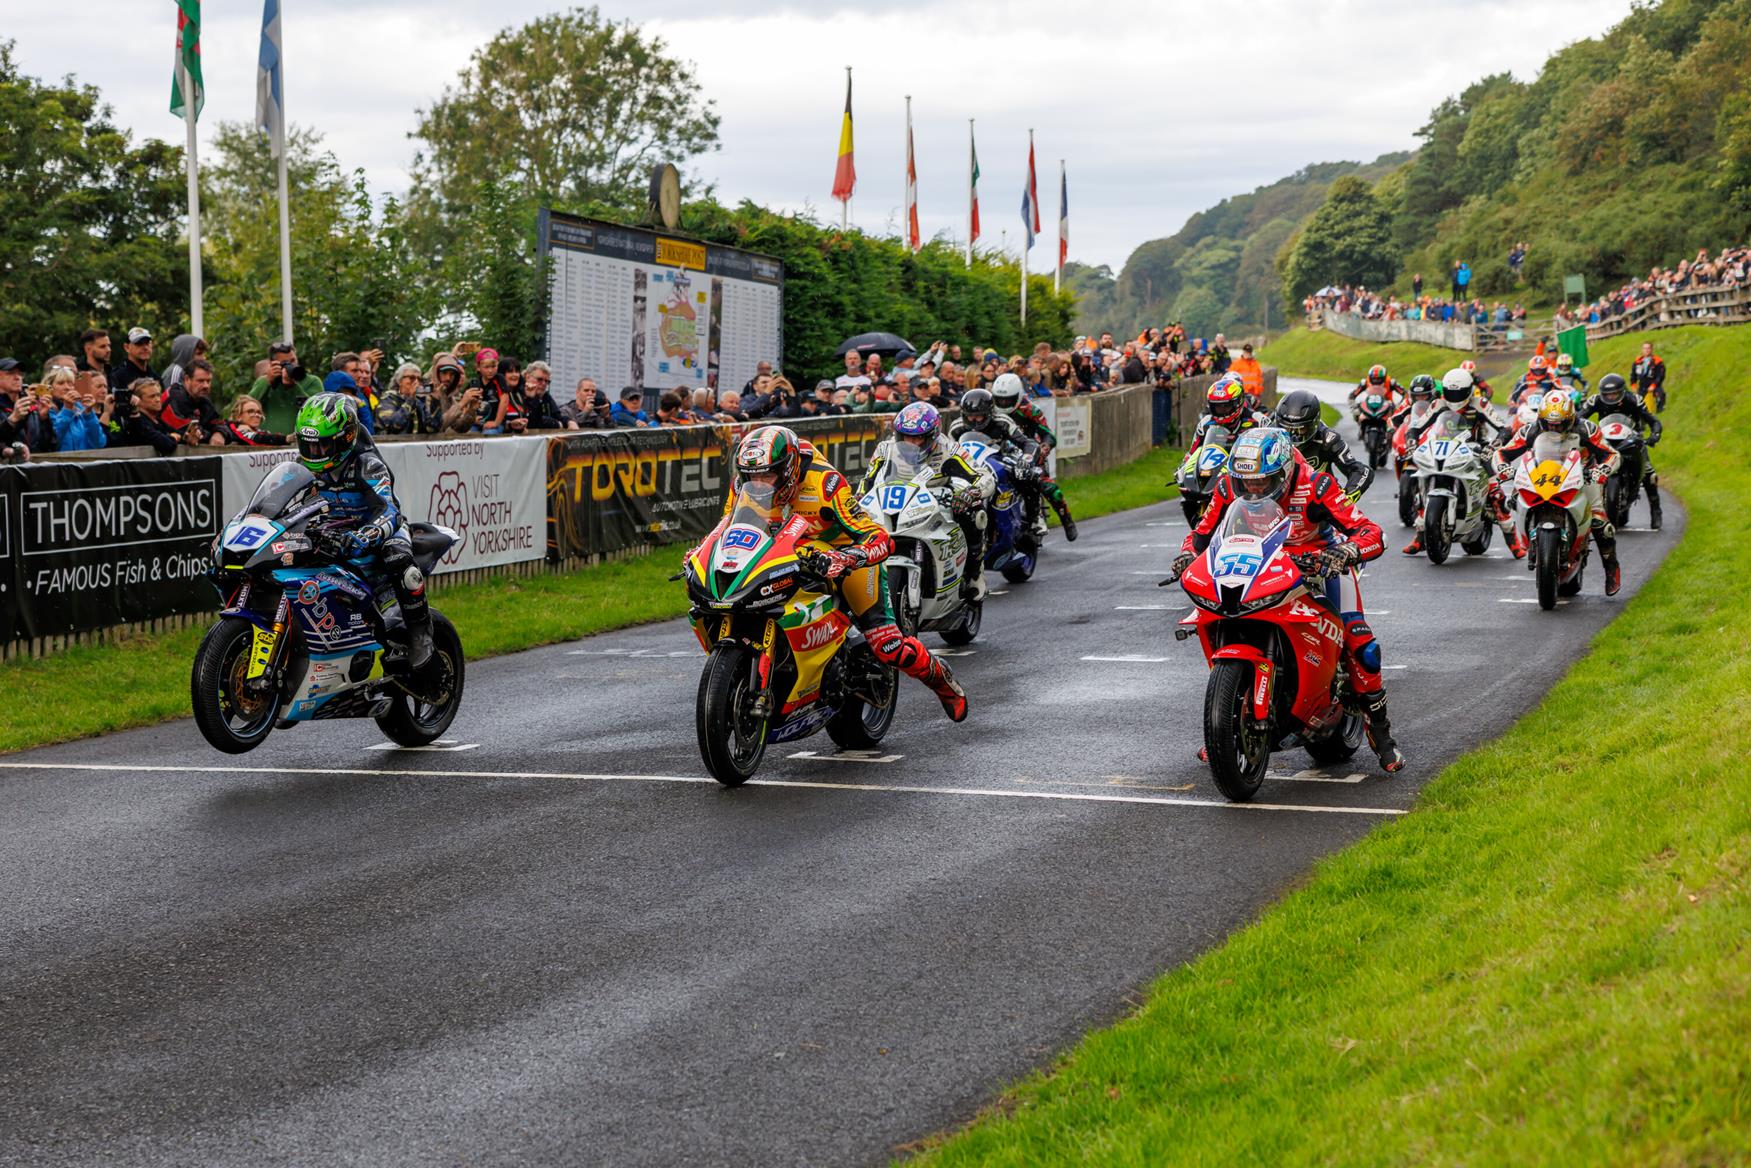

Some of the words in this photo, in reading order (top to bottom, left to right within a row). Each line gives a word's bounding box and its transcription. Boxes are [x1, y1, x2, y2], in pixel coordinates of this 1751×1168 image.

[301, 427, 319, 437] Arai
[1609, 424, 1622, 435] 3
[1435, 441, 1449, 455] 71
[472, 473, 500, 499] VISIT
[566, 448, 722, 503] TOROTEC
[1535, 473, 1562, 487] 44
[882, 486, 907, 510] 19
[29, 489, 211, 544] THOMPSONS
[471, 501, 513, 528] NORTH
[226, 526, 268, 547] 16
[723, 528, 762, 551] 60
[784, 518, 806, 537] SWAN
[472, 525, 533, 556] YORKSHIRE
[35, 563, 112, 596] FAMOUS
[115, 560, 147, 586] Fish
[151, 557, 162, 581] &
[166, 553, 209, 582] Chips
[1213, 553, 1264, 578] 55
[801, 620, 834, 649] SWAN
[1288, 601, 1344, 649] HONDA
[882, 639, 902, 653] Weise
